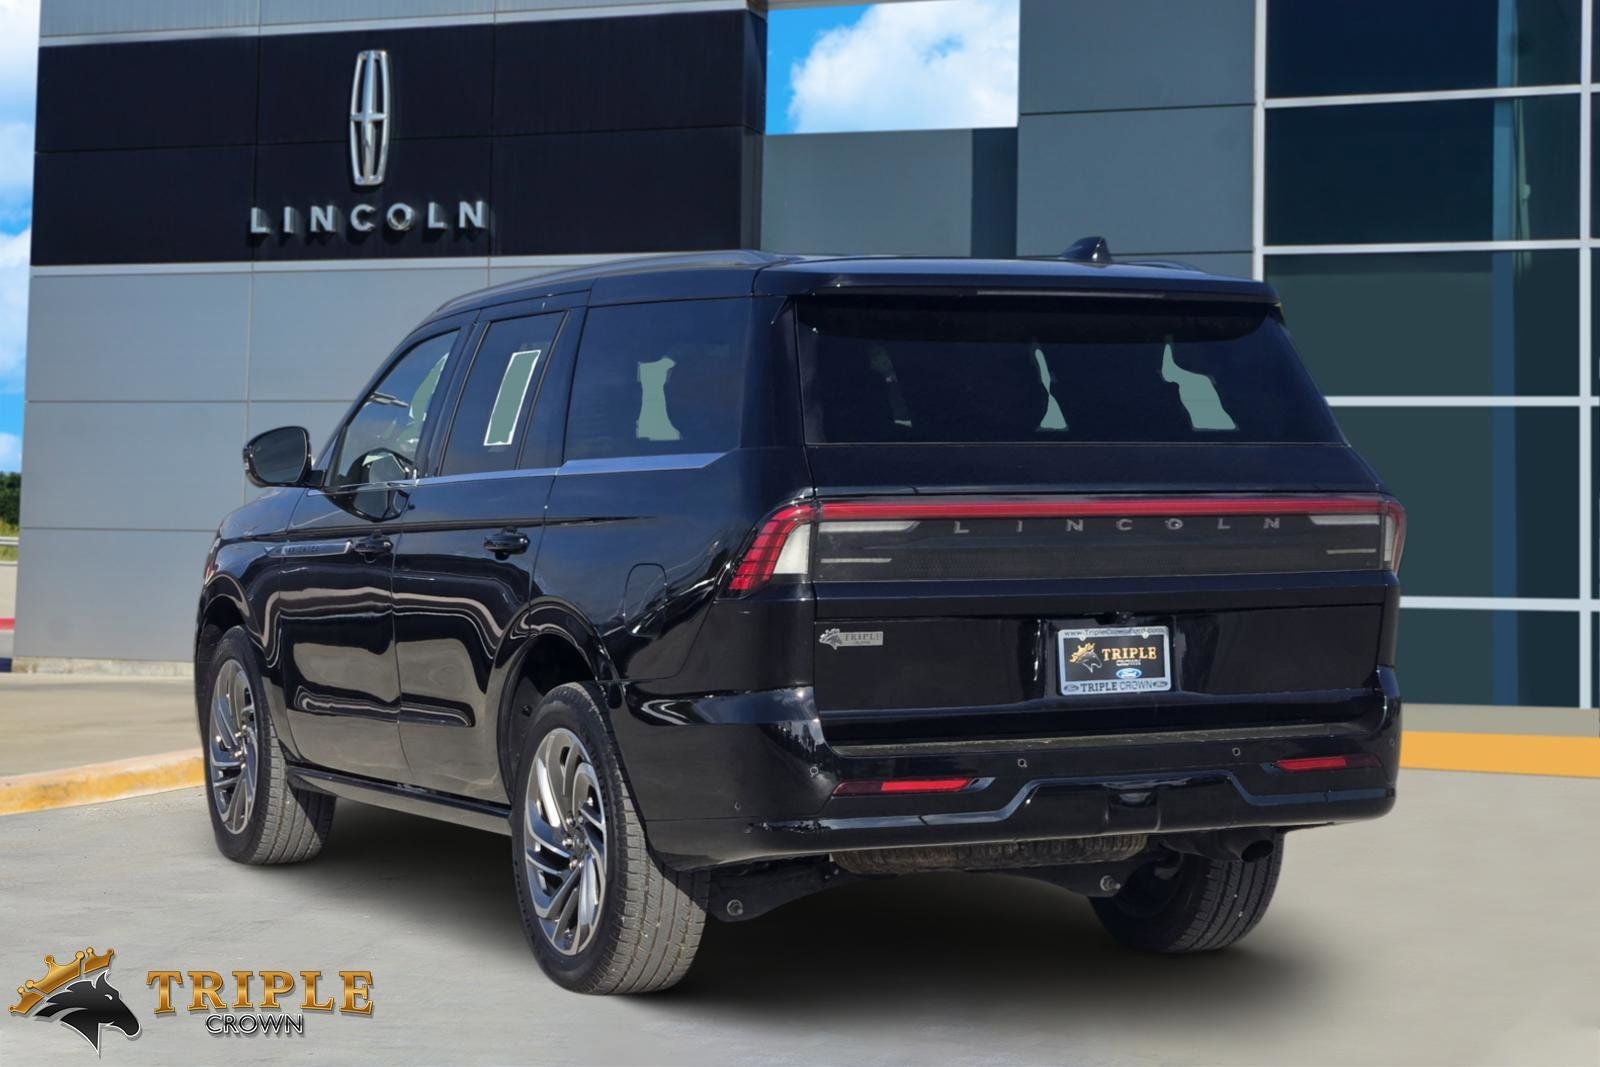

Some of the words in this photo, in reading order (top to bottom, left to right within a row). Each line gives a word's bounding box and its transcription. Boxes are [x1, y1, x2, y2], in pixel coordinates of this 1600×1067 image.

[250, 200, 488, 234] LINCOLN
[953, 517, 1282, 535] LINCOLN
[1102, 647, 1157, 661] TRIPLE
[1080, 681, 1118, 693] TRIPLE
[1119, 680, 1153, 690] CROWN
